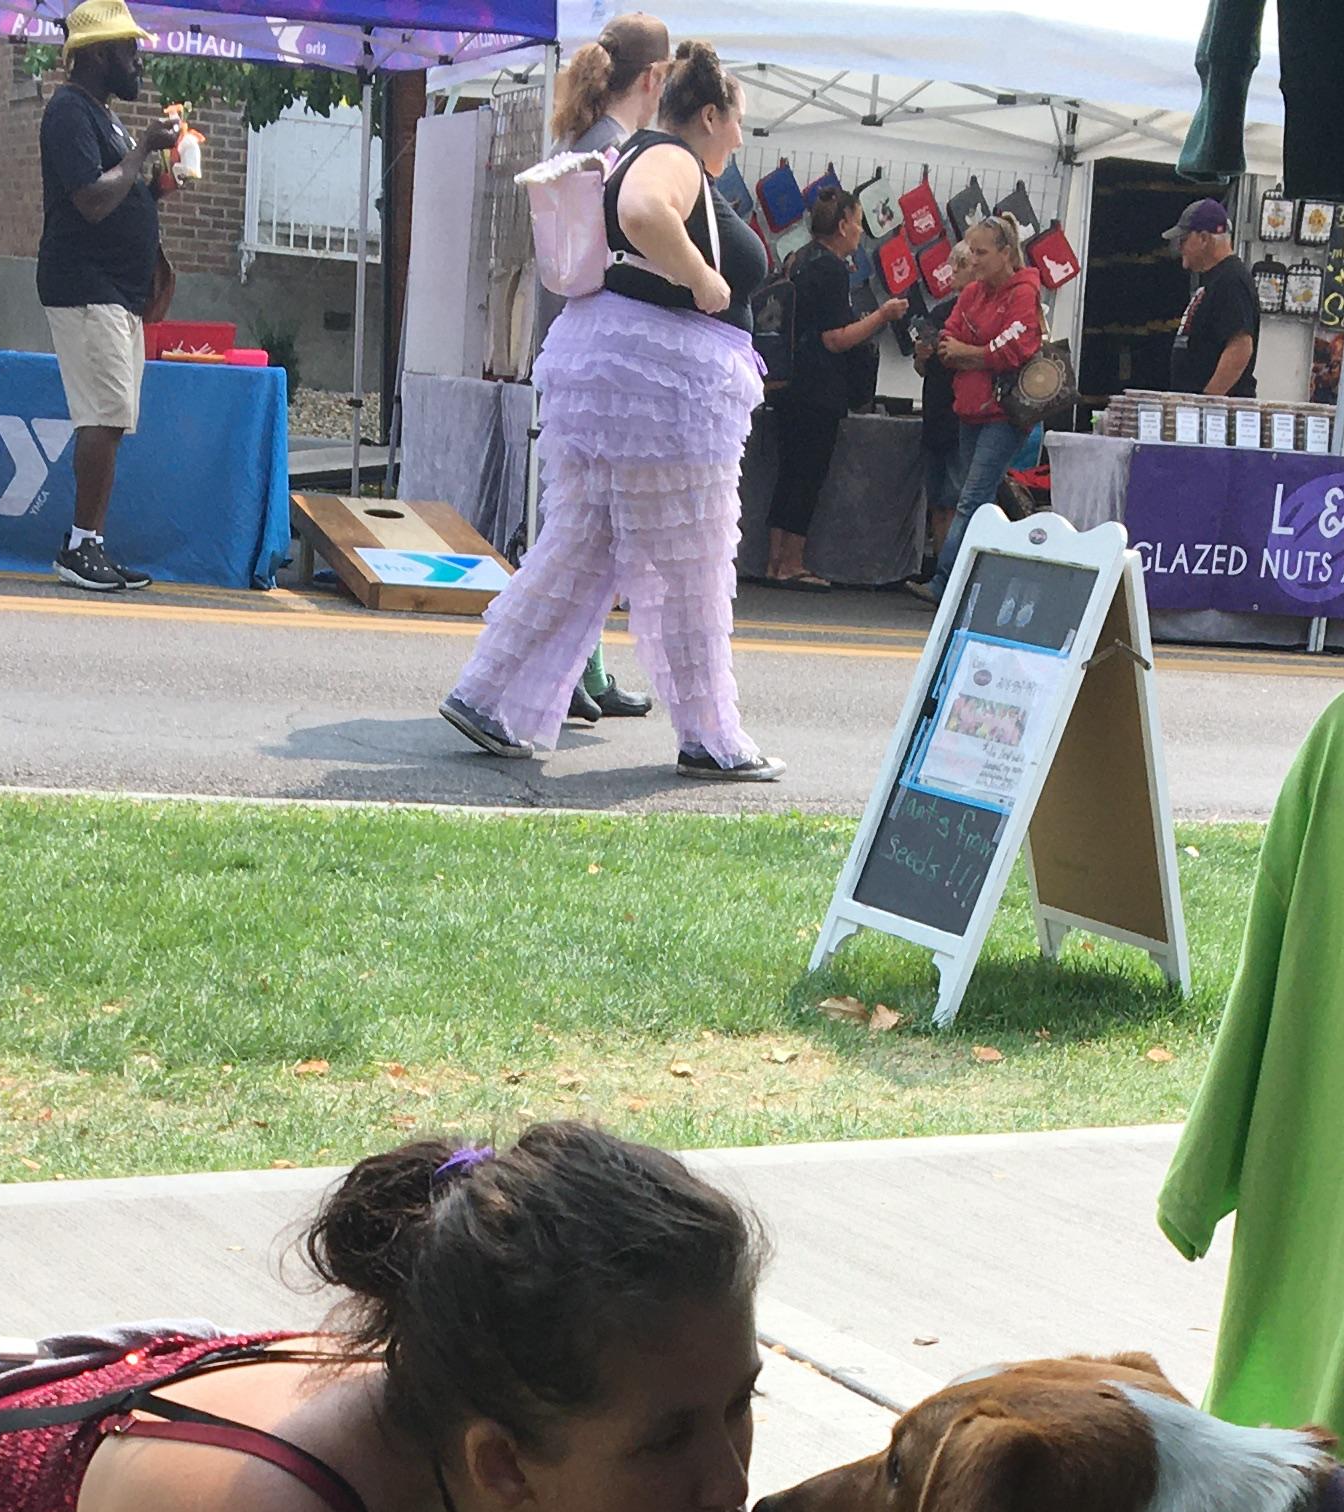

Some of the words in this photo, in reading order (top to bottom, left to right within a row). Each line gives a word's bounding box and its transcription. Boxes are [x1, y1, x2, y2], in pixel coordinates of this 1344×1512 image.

[29, 490, 51, 516] YMCA
[1270, 483, 1295, 536] L
[1136, 541, 1248, 577] GLAZED
[1259, 548, 1333, 584] NUTS
